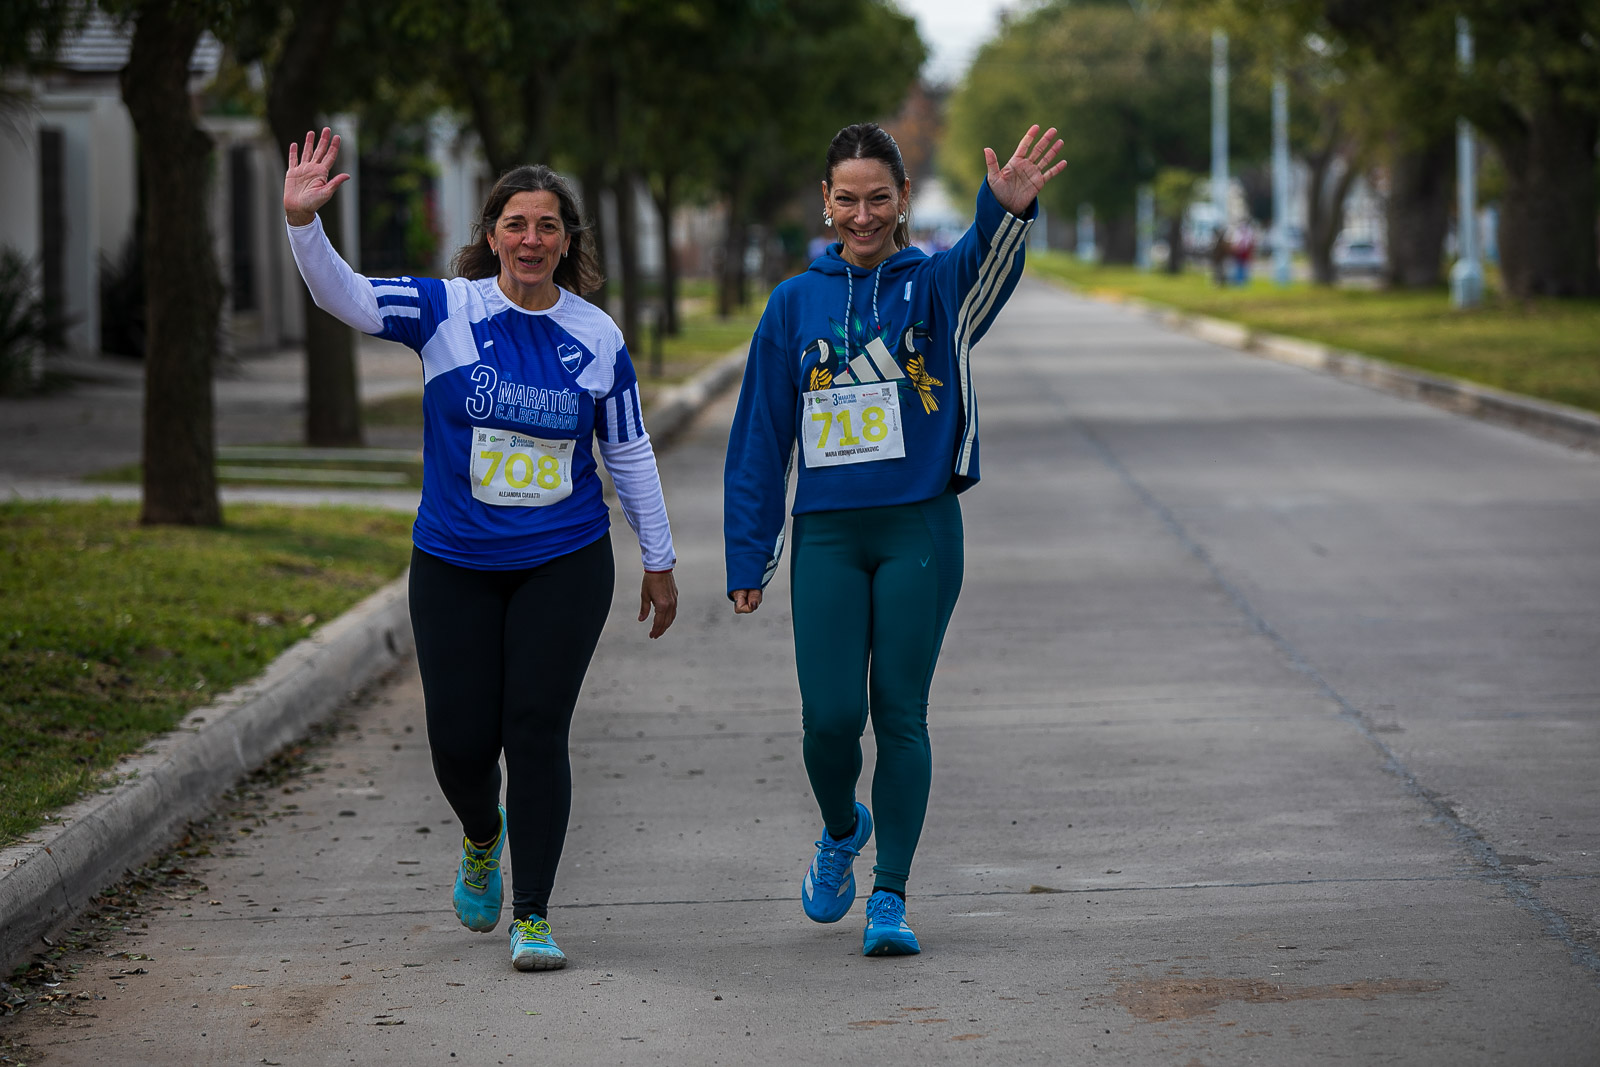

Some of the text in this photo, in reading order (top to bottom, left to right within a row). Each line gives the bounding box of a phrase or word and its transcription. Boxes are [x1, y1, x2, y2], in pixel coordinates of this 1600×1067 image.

[466, 364, 579, 420] 3 MARATÓN
[832, 393, 839, 406] 3
[510, 435, 517, 448] 3
[811, 406, 889, 449] 718
[480, 450, 562, 490] 708
